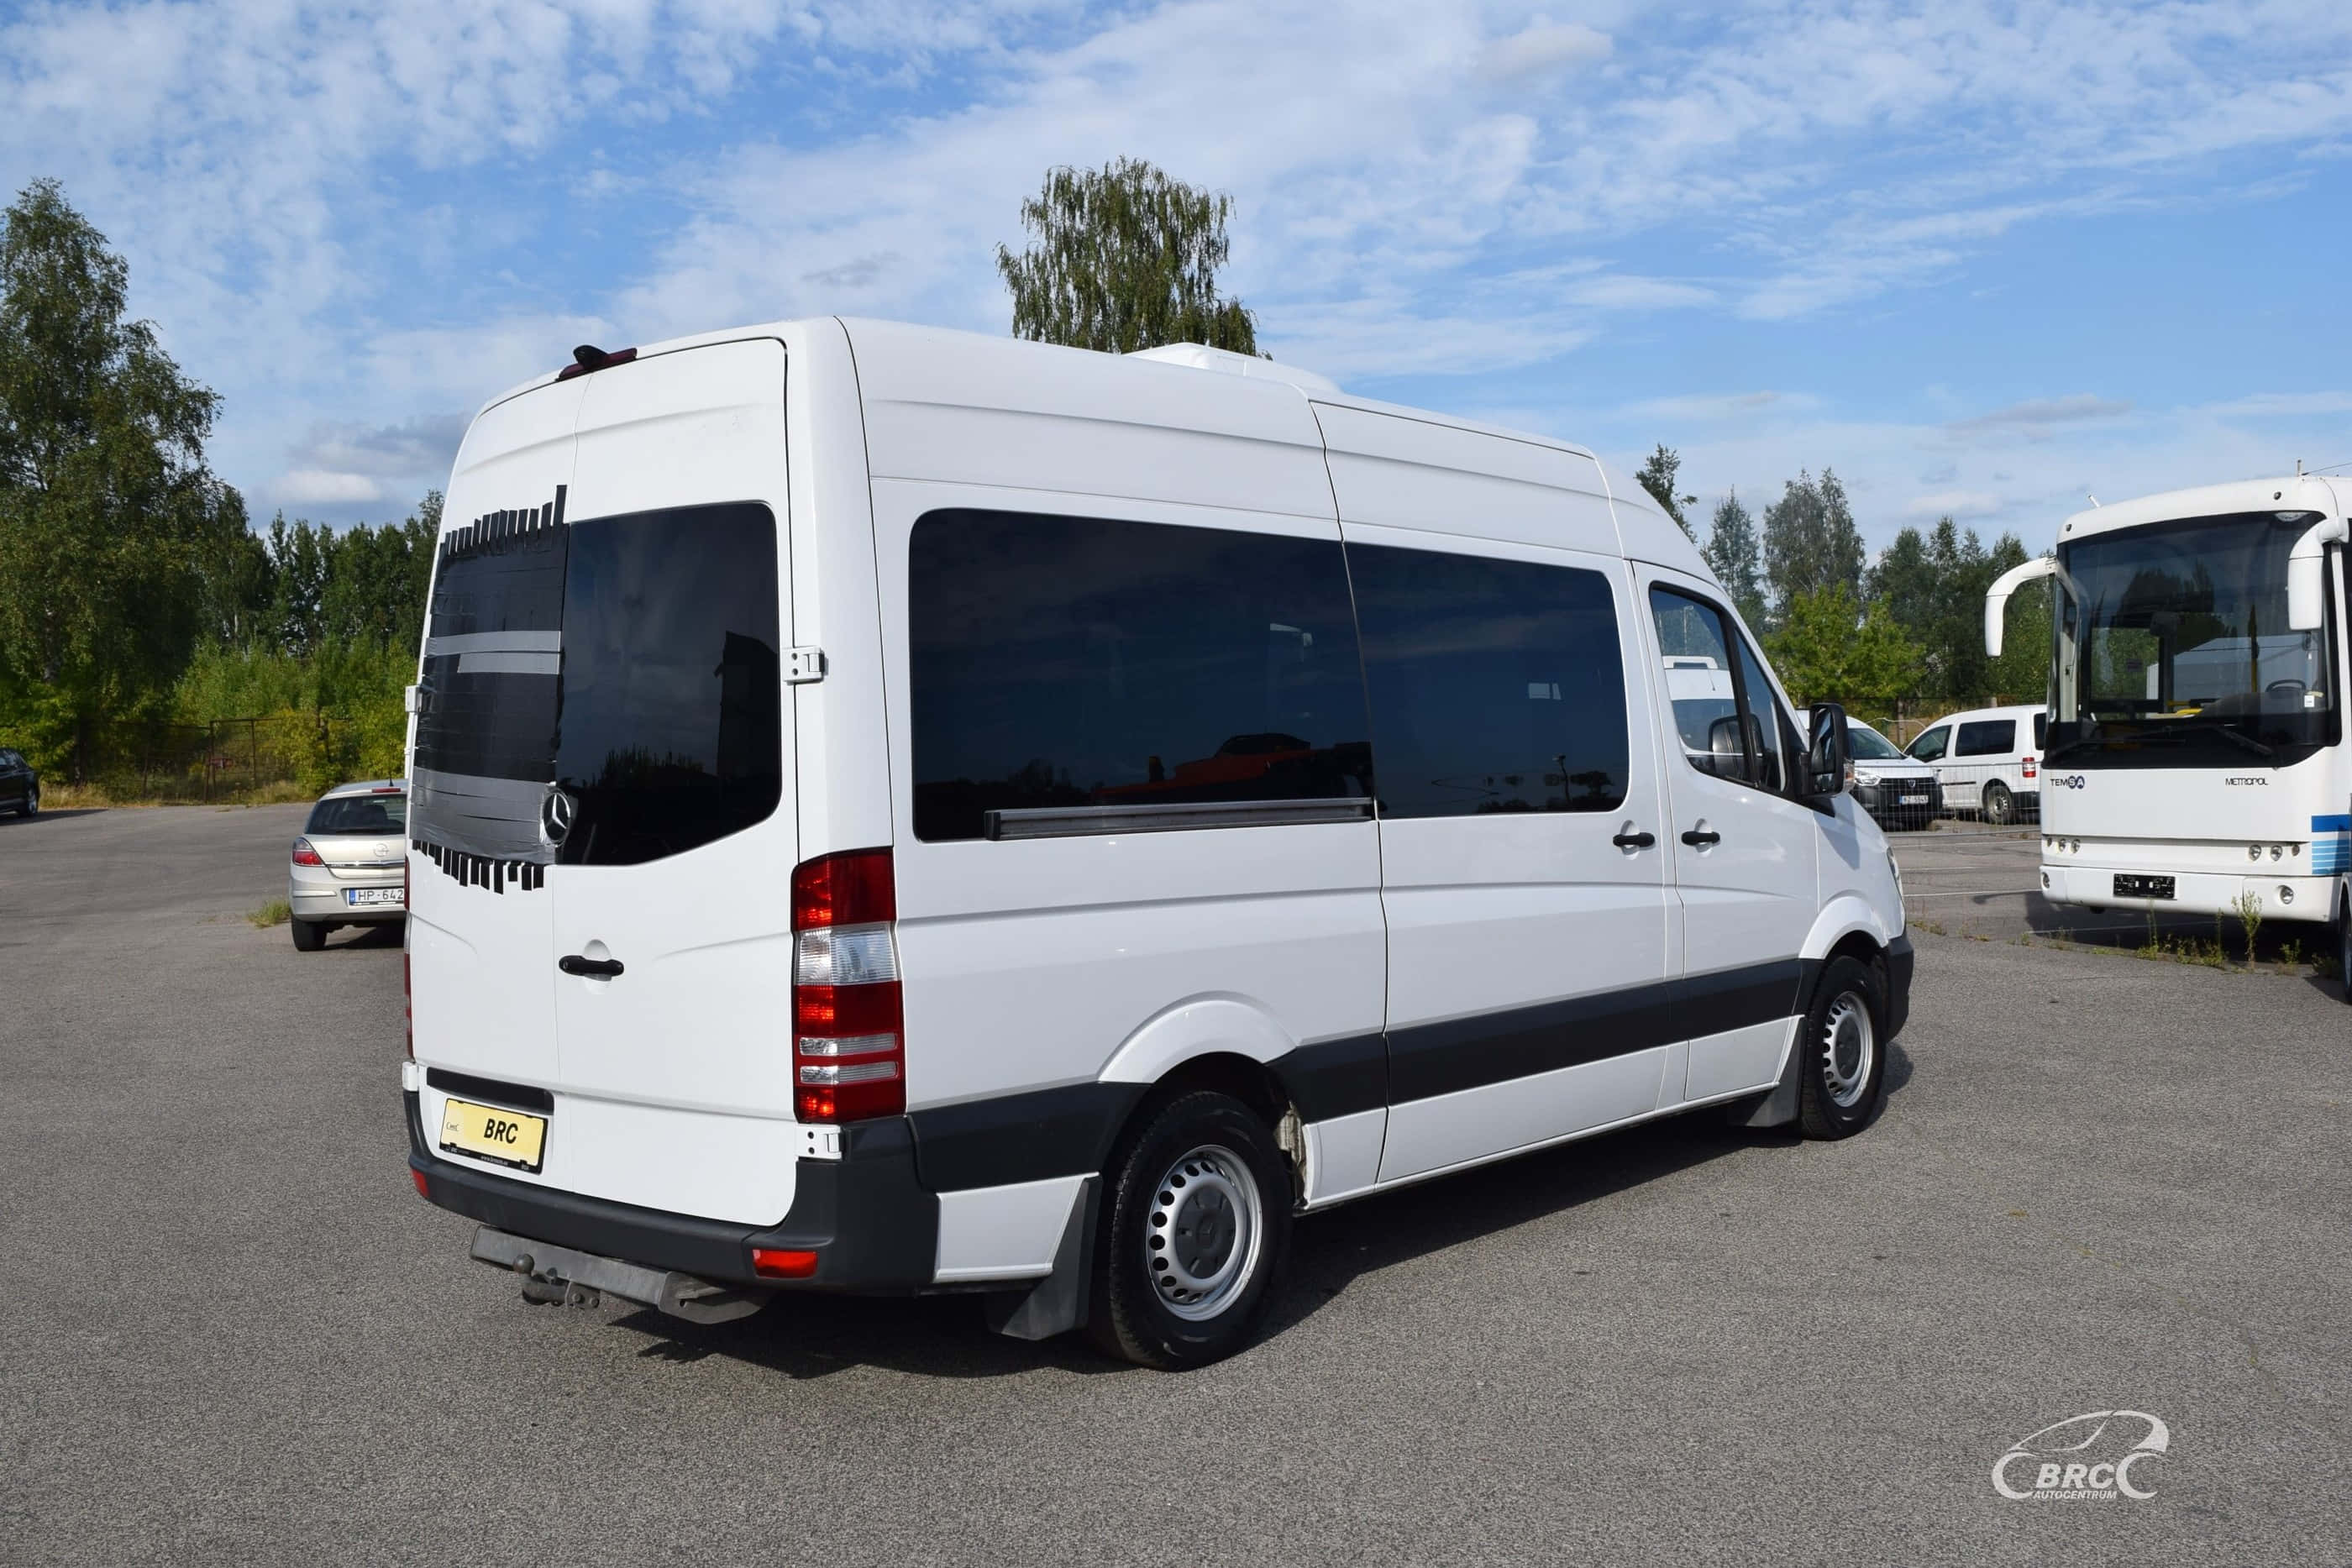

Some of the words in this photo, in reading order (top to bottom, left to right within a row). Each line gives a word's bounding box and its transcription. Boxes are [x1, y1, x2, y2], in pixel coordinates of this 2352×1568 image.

[2050, 775, 2085, 789] TEMSA
[2225, 778, 2269, 786] METROPOL
[484, 1118, 518, 1144] BRC
